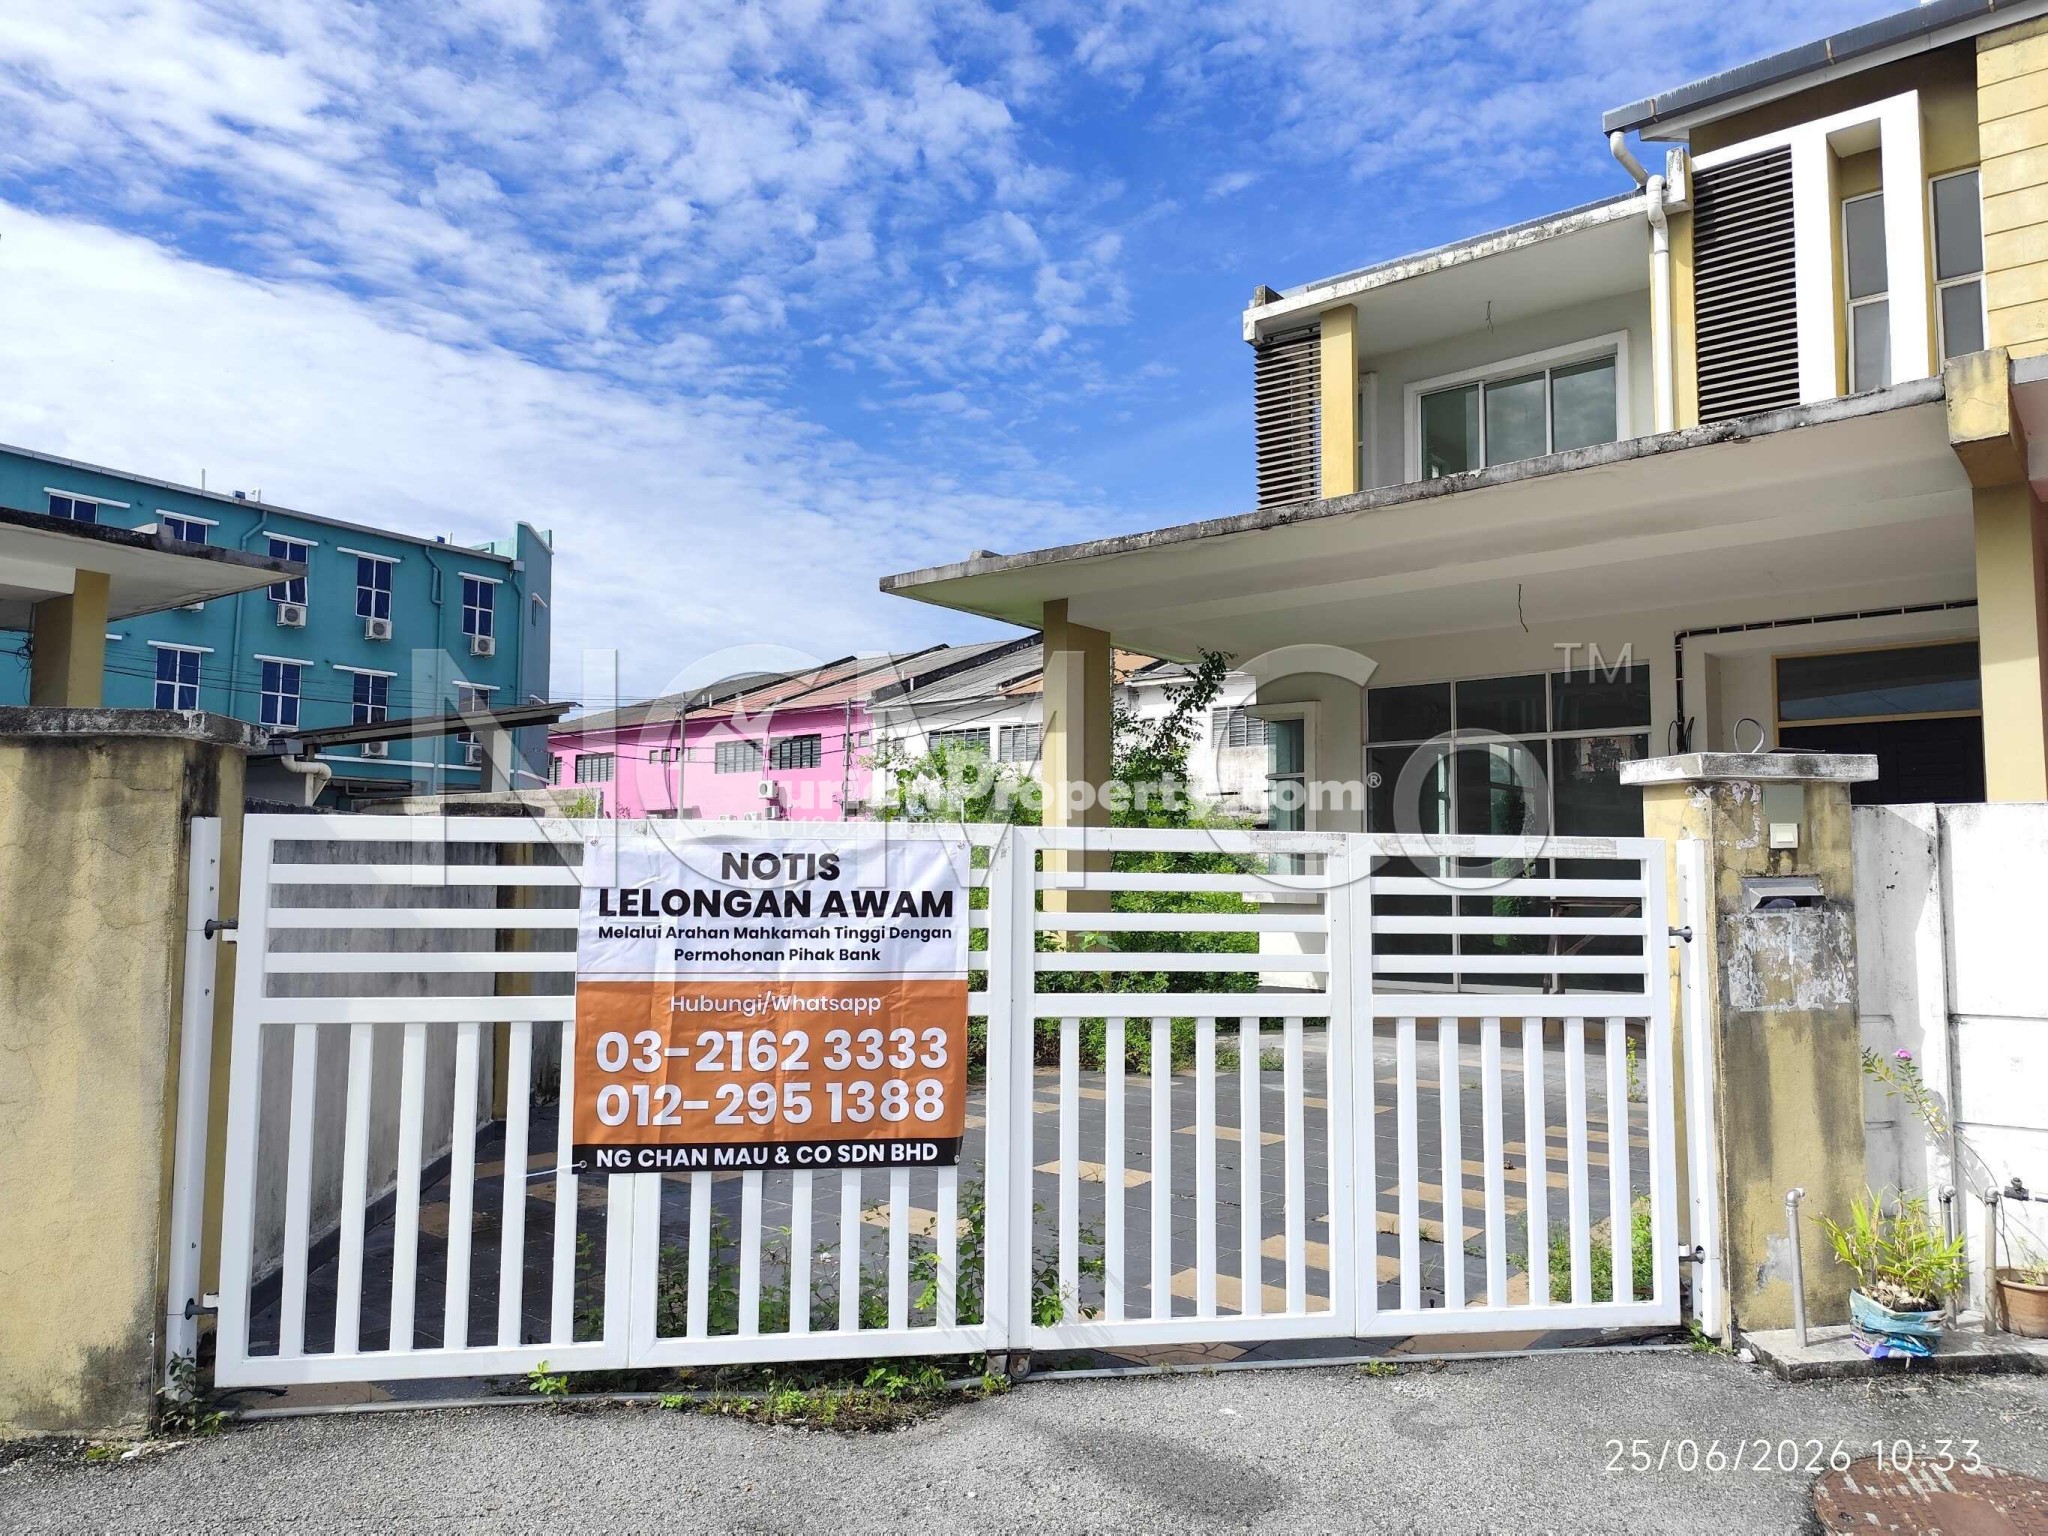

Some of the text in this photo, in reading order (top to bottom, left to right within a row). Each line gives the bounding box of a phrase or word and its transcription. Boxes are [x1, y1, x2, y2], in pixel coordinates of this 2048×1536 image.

[721, 852, 841, 882] NOTIS
[599, 889, 953, 918] LELONGAN AWAM
[598, 926, 952, 943] Melalui Arahan Mahkamah Tinggi Dengan
[674, 948, 881, 962] Permohonan Pihak Bank
[670, 991, 881, 1017] Hubungi/Whatsapp
[595, 1027, 948, 1073] 03-2162 3333
[596, 1079, 944, 1126] 012-295 1388
[596, 1143, 938, 1167] NG CHAN MAU & CO SDN BHD
